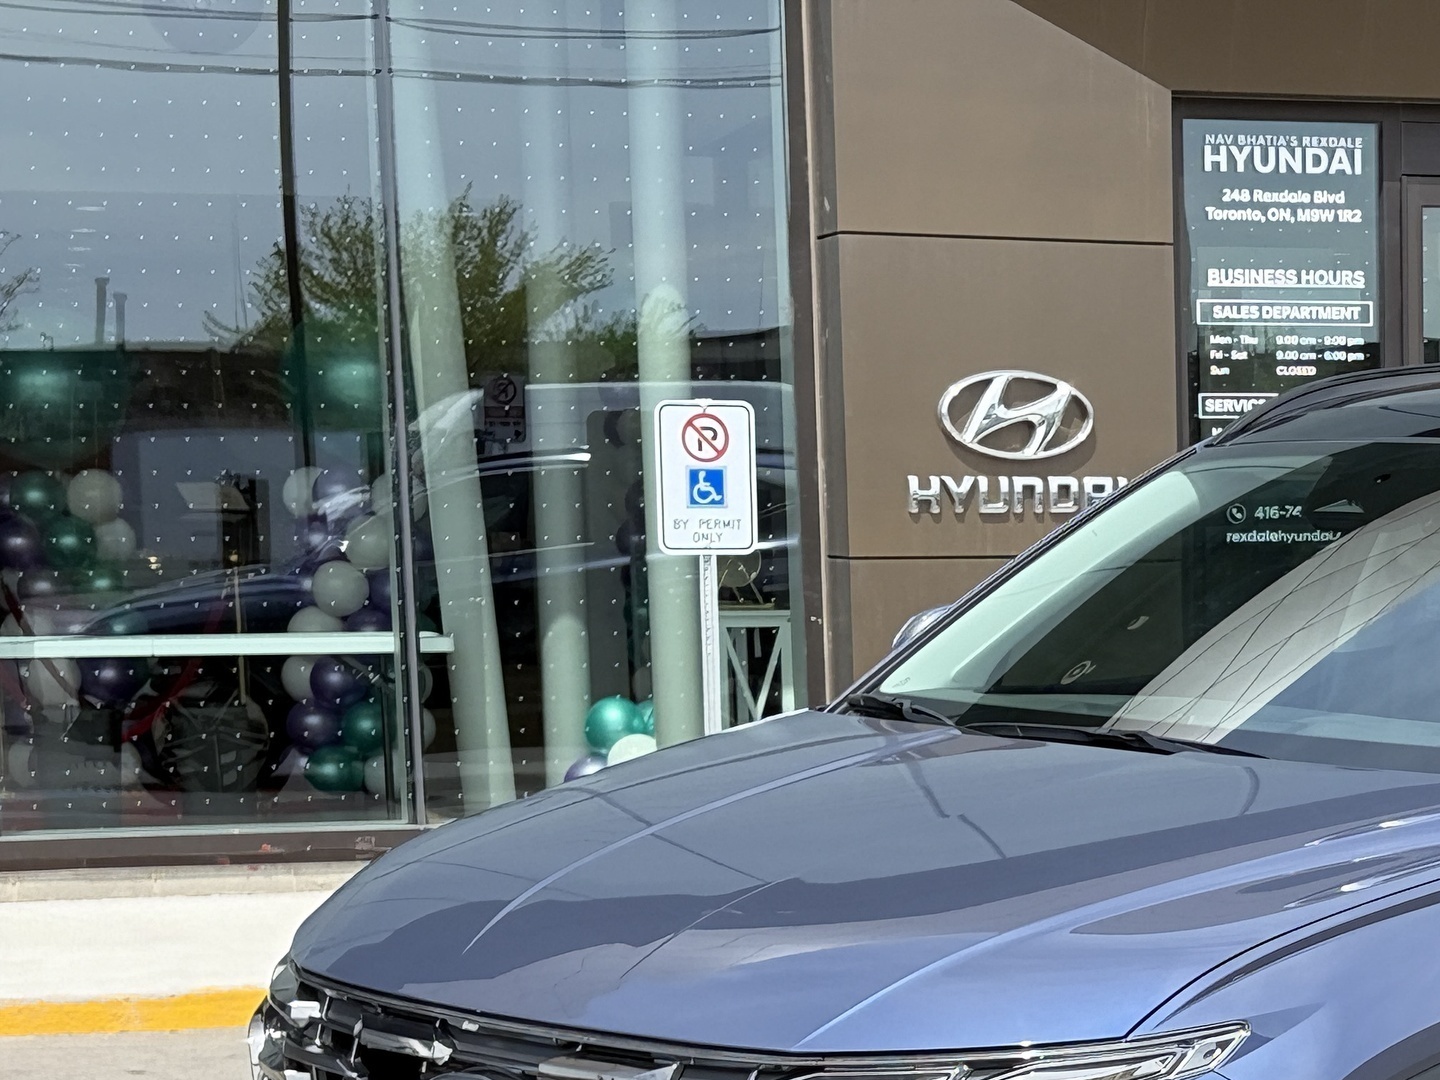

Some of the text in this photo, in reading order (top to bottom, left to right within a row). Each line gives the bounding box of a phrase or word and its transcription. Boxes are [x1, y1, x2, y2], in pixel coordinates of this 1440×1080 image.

[1205, 134, 1363, 148] NAV BHATIA'S REXDALE
[1203, 144, 1363, 175] HYUNDAI
[1221, 188, 1346, 204] 248 Rexdale Blvd
[1205, 206, 1363, 223] Toronto, ON, M9W 1R2
[1207, 268, 1365, 286] BUSINESS HOURS
[1212, 305, 1362, 321] SALES DEPARTMENT
[672, 518, 742, 530] BY PERMIT
[692, 531, 723, 543] ONLY
